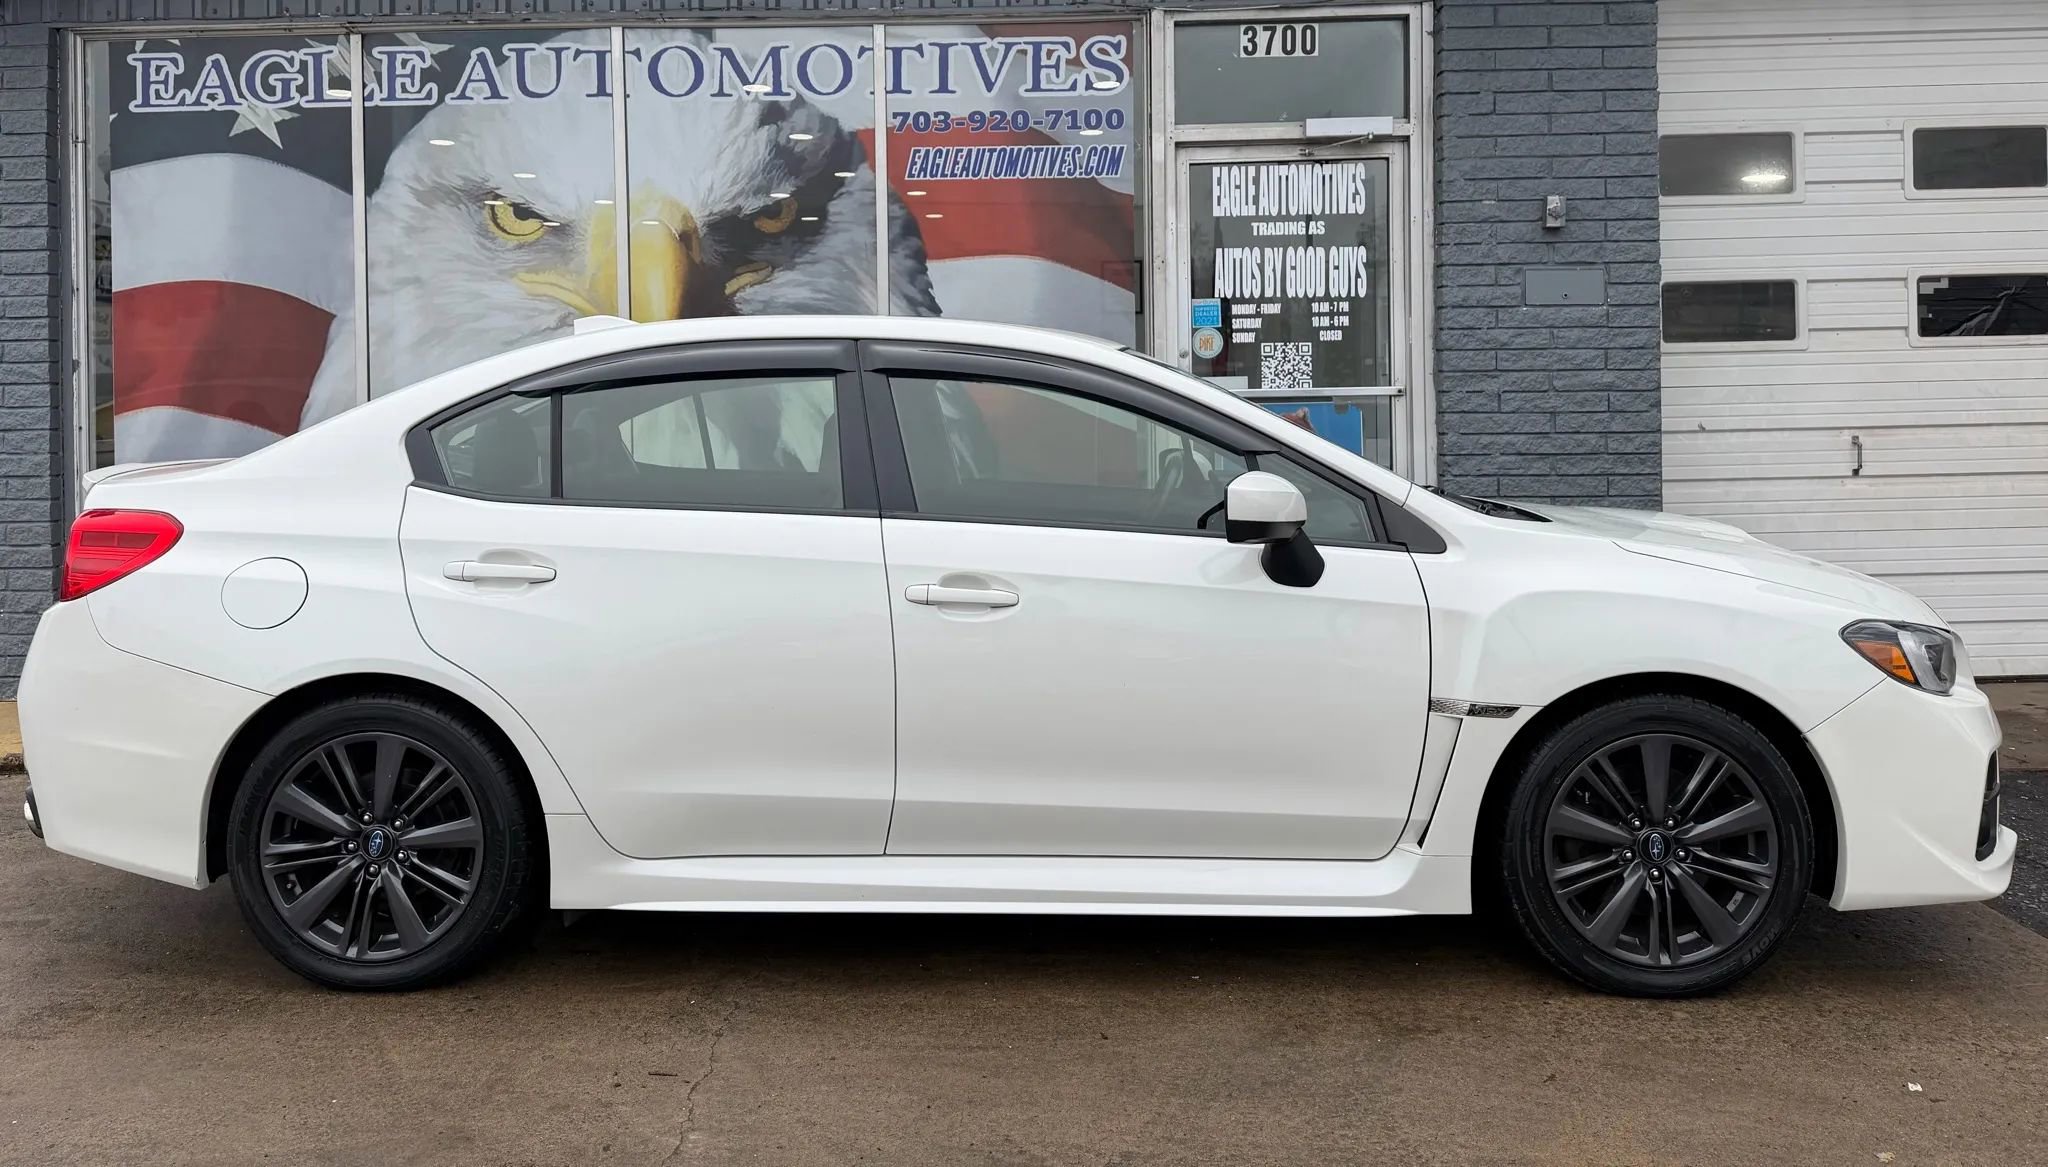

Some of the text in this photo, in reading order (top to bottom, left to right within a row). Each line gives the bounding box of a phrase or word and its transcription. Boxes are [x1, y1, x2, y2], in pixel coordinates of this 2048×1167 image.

[1242, 24, 1317, 56] 3700
[128, 36, 1129, 111] EAGLE AUTOMOTIVES
[892, 109, 1125, 133] 703-920-7100
[905, 145, 1126, 180] EAGLEAUTOMOTIVES.COM
[1212, 162, 1366, 217] EAGLE AUTOMOTIVES
[1251, 220, 1326, 236] TRADING AS
[1214, 245, 1367, 299] AUTOS BY GOOD GUYS
[1231, 303, 1256, 315] MONDAY
[1260, 303, 1282, 314] FRIDAY
[1311, 302, 1318, 313] 10
[1319, 302, 1330, 313] AM
[1333, 302, 1338, 312] 7
[1339, 301, 1350, 313] PM
[1231, 317, 1262, 329] SATURDAY
[1311, 316, 1319, 327] 10
[1319, 316, 1330, 327] AM
[1334, 316, 1339, 327] 6
[1339, 316, 1350, 327] PM
[1232, 332, 1256, 343] SUNDAY
[1319, 330, 1342, 341] CLOSED
